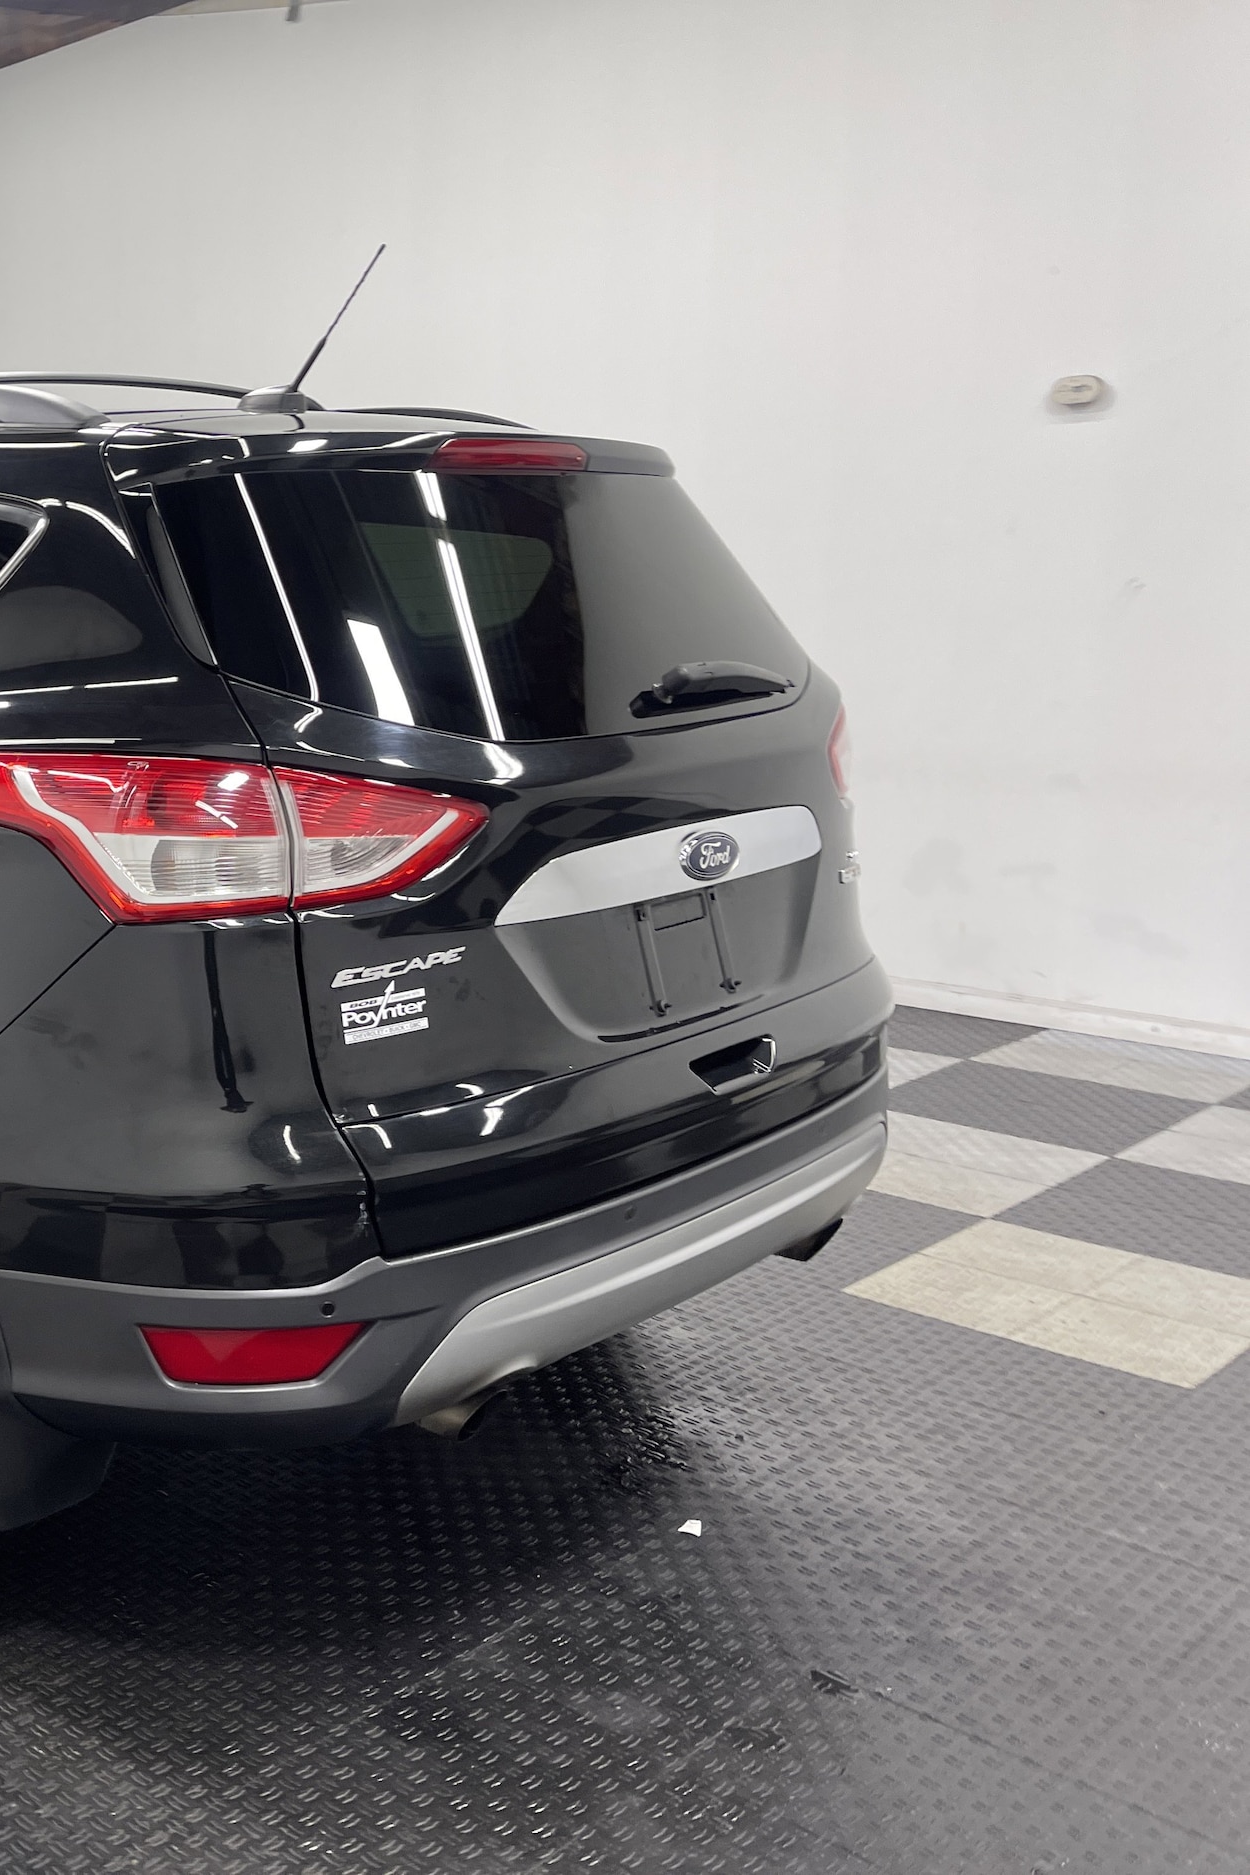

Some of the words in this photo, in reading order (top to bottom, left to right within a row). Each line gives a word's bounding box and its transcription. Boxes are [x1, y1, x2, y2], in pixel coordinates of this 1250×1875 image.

[700, 841, 731, 869] Ford
[330, 946, 466, 989] ESCAPE
[341, 1000, 427, 1030] Poynter
[350, 999, 377, 1009] BOB
